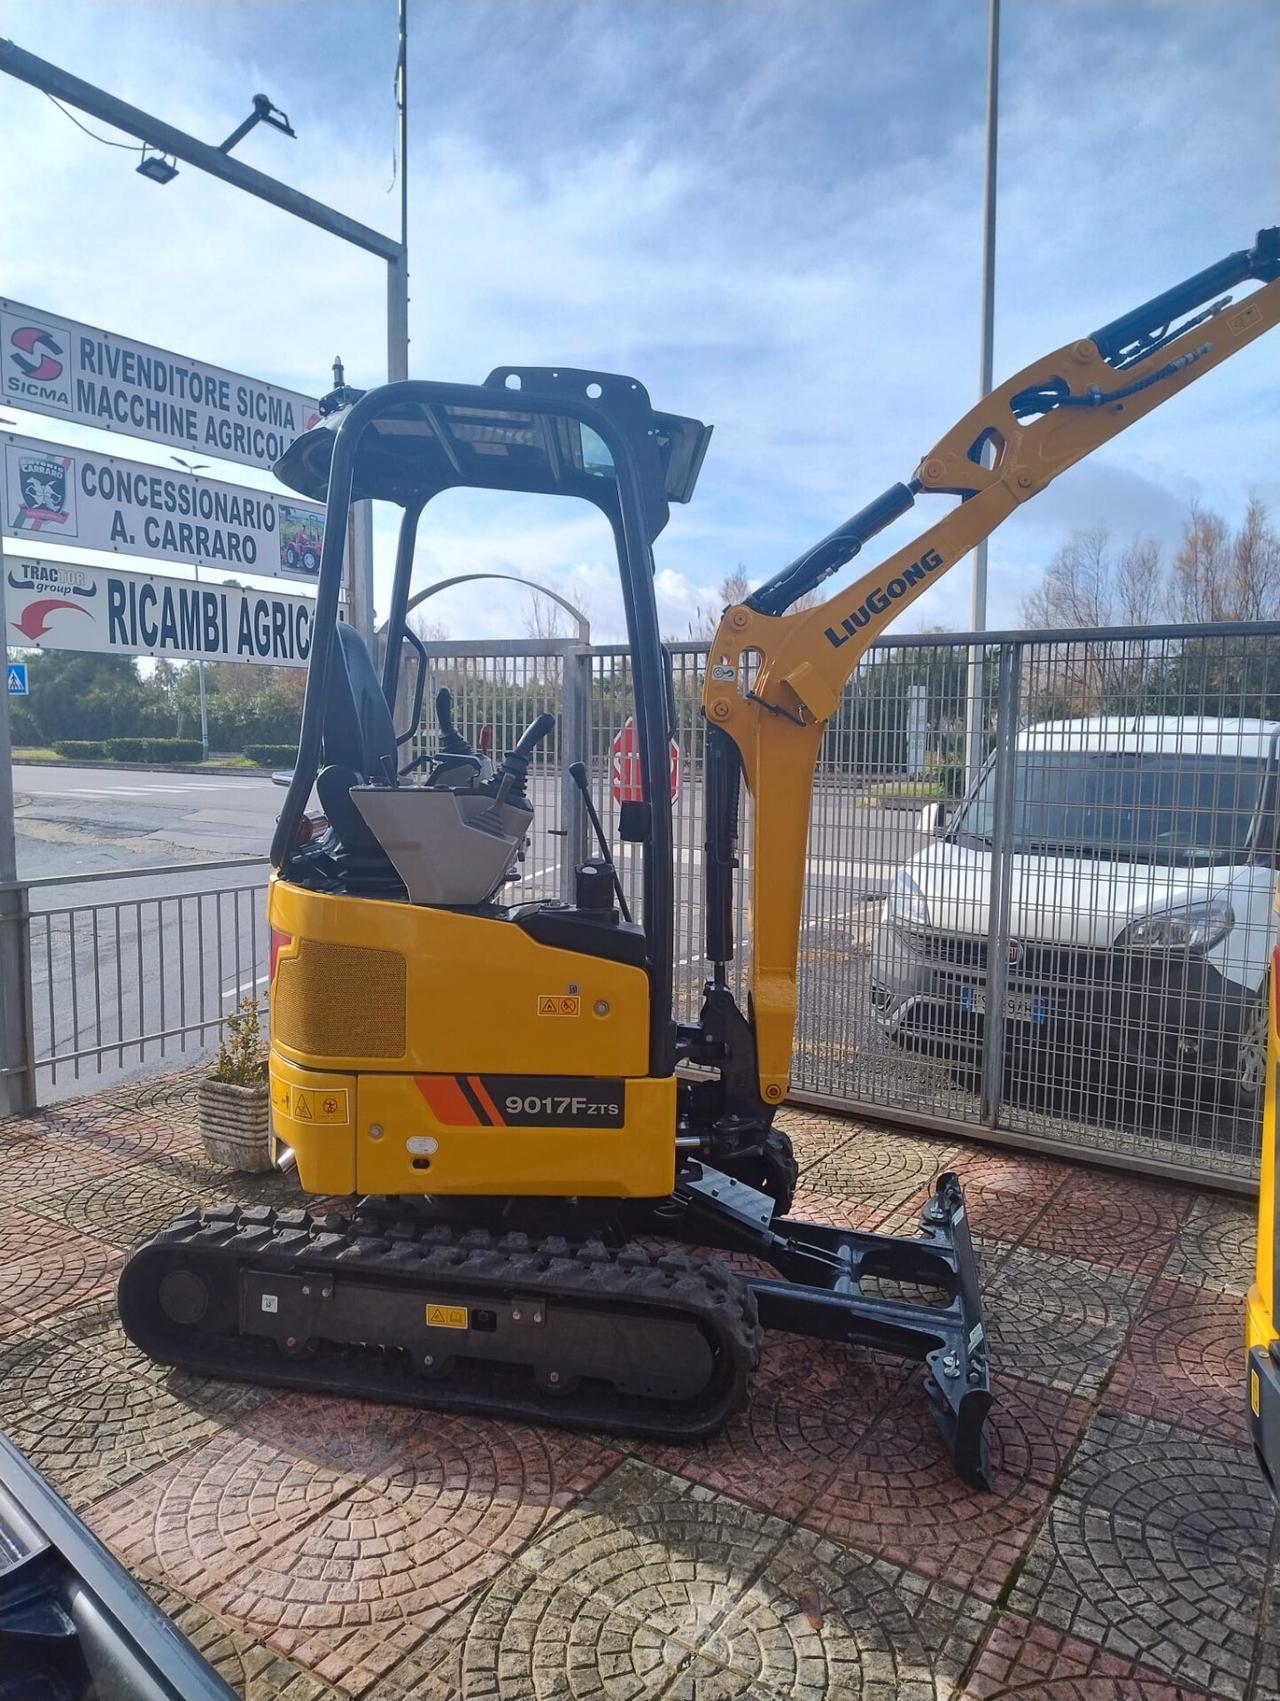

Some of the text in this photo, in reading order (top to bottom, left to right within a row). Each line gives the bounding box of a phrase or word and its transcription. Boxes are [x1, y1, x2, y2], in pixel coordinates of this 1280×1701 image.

[7, 376, 69, 405] SICMA
[80, 336, 295, 431] RIVENDITORE SICMA
[77, 379, 294, 462] MACCHINE AGRICOL
[81, 462, 275, 533] CONCESSIONARIO
[110, 510, 256, 565] A. CARRARO
[21, 564, 86, 587] TRACTOR
[36, 583, 72, 596] group
[108, 578, 229, 655] RICAMBI
